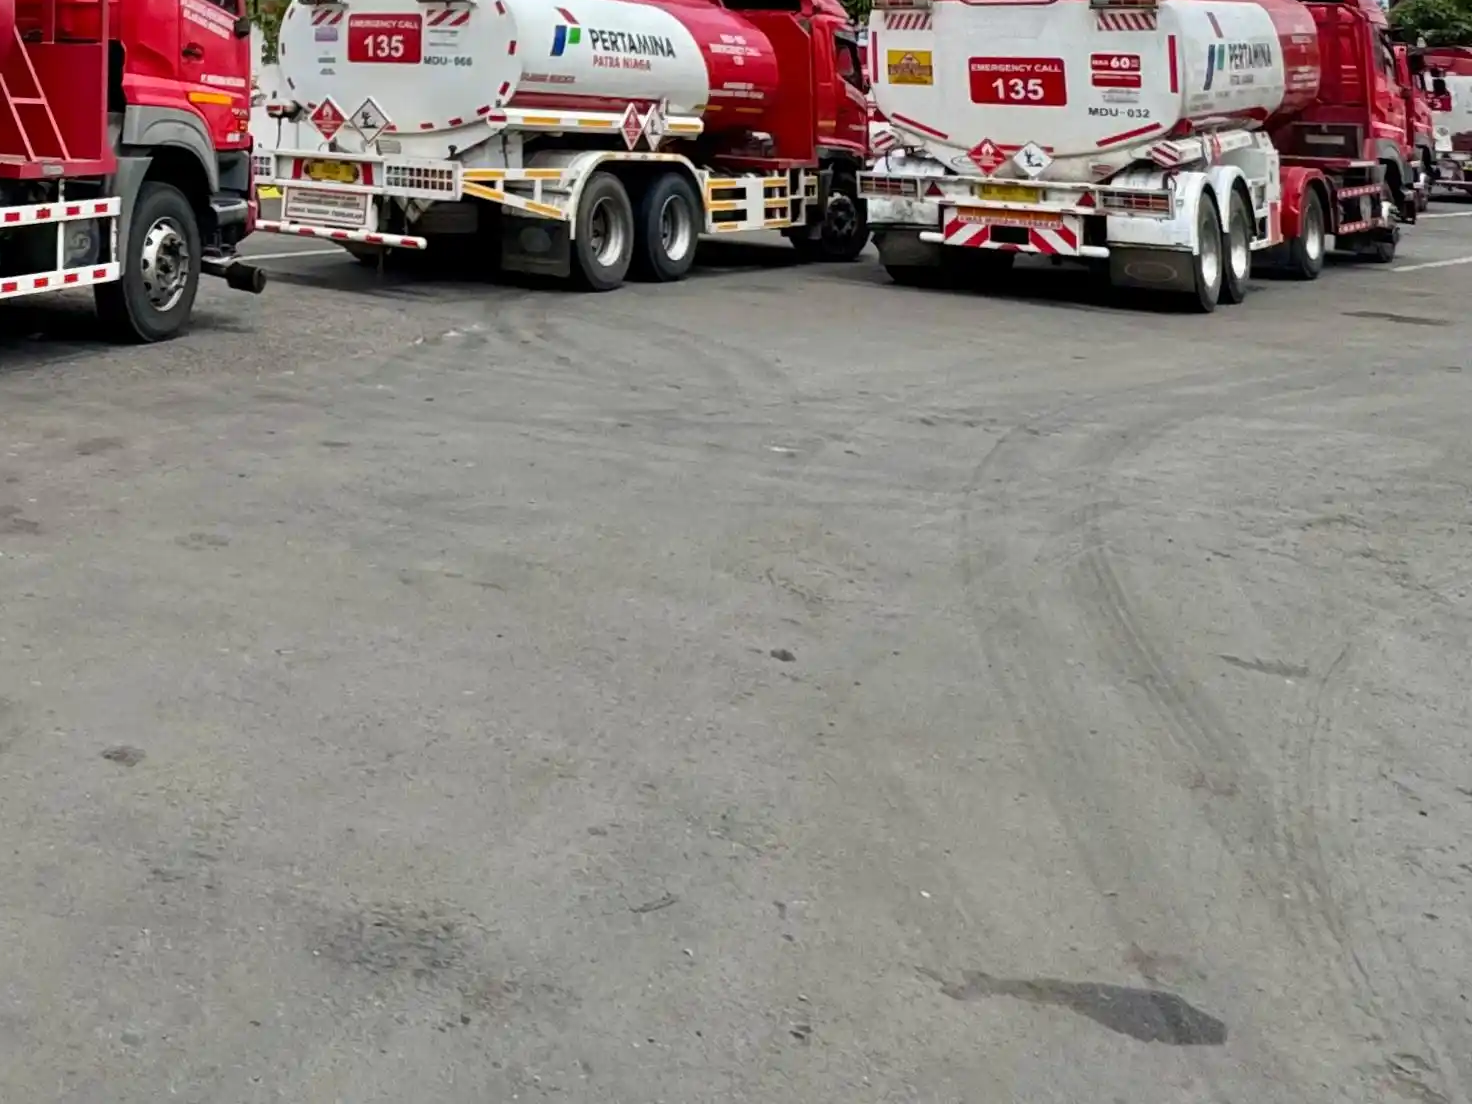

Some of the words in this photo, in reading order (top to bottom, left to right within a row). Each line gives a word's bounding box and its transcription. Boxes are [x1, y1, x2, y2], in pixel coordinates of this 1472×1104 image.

[363, 34, 405, 58] 135
[588, 28, 676, 58] PERTAMINA
[593, 55, 621, 68] PATRA
[623, 56, 652, 71] NIAGA
[971, 63, 1032, 72] EMERGENCY
[1034, 64, 1062, 72] CALL
[1110, 56, 1130, 69] 60
[991, 78, 1044, 100] 135
